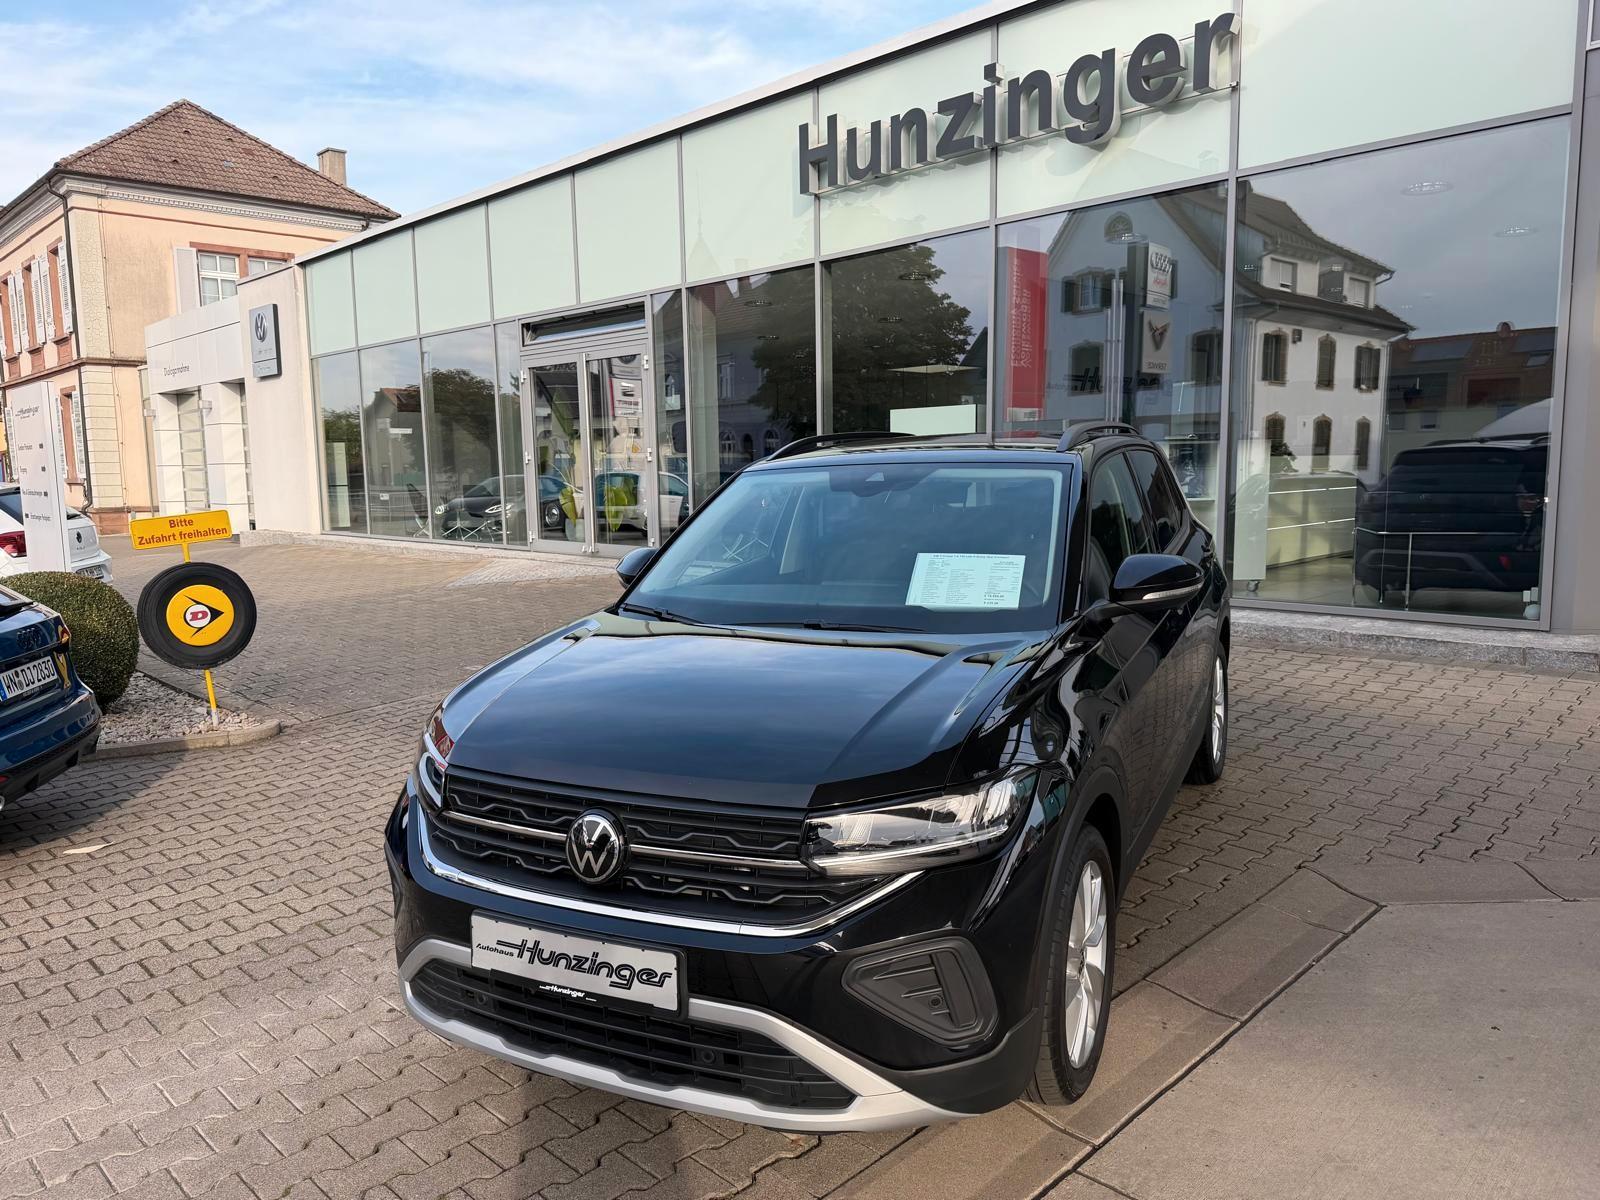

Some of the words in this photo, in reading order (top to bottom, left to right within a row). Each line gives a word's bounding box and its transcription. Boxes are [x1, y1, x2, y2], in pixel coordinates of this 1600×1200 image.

[798, 12, 1240, 196] Hunzinger
[138, 532, 177, 546] Zufahrt
[179, 527, 228, 540] freihalten
[168, 519, 194, 529] Bitte
[476, 943, 514, 957] Autohaus
[496, 938, 673, 990] Hunzinger
